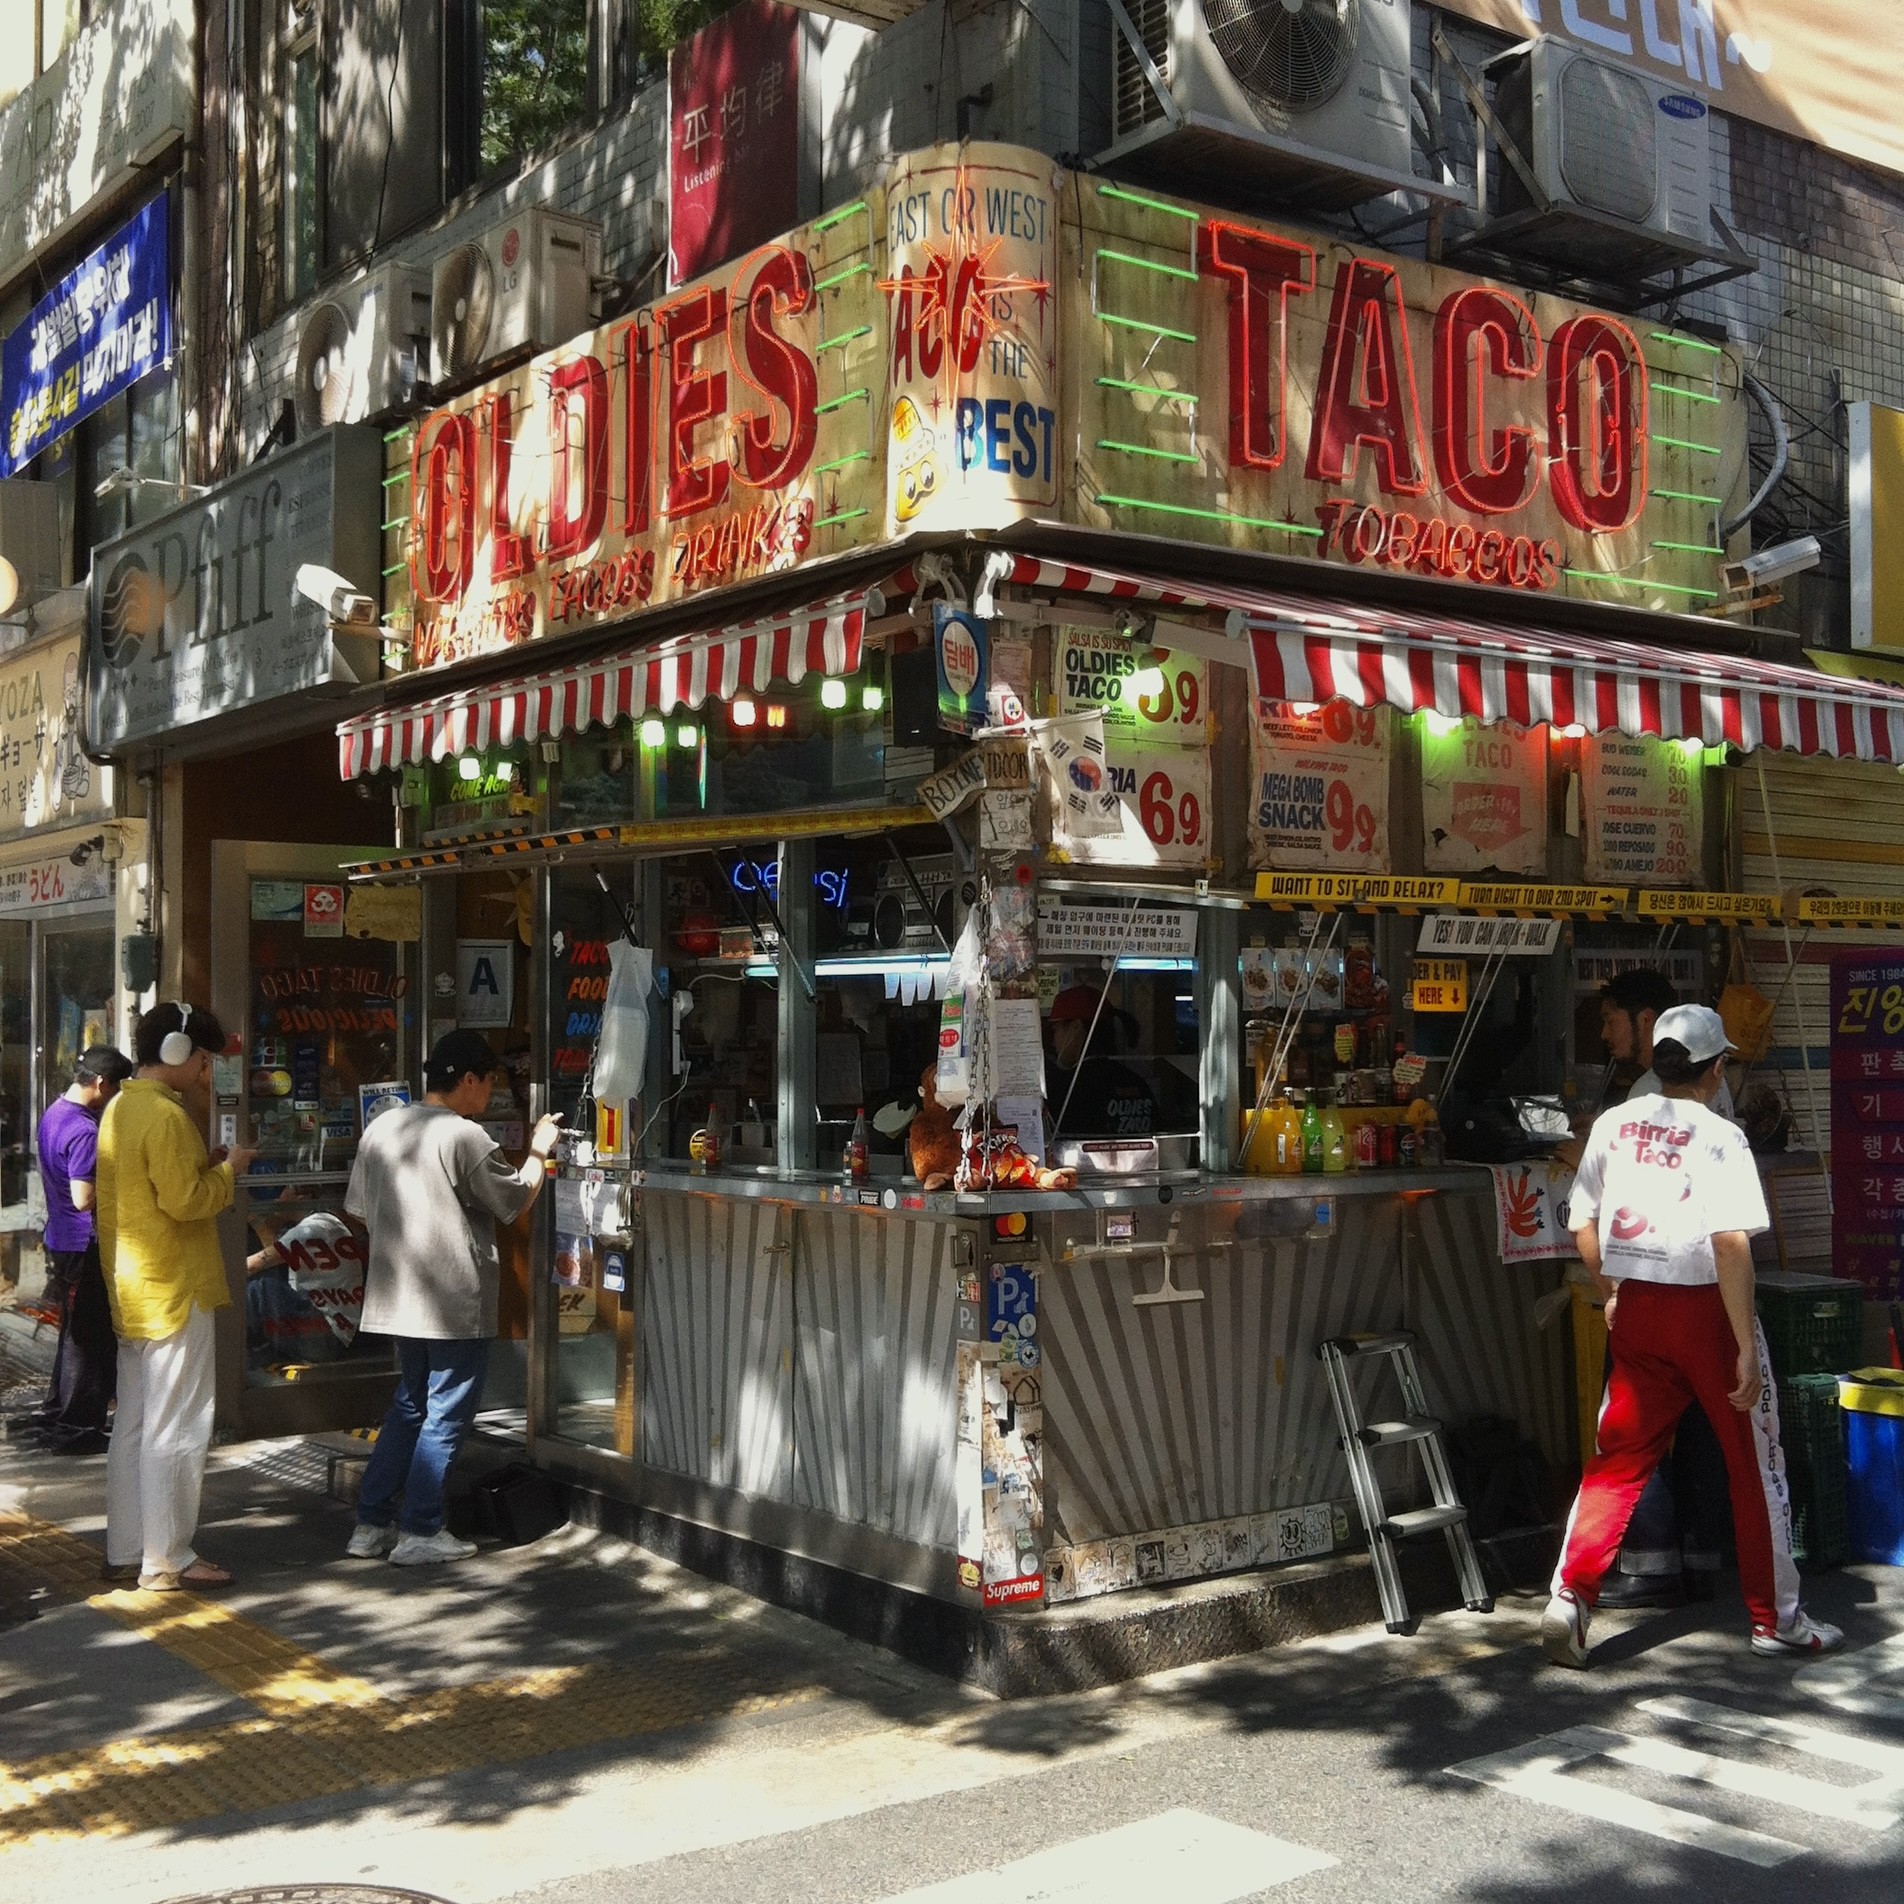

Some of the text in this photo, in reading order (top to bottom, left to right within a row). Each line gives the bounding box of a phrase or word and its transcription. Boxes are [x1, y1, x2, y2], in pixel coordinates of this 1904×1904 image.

[1662, 96, 1704, 118] SAMSUNG
[889, 187, 1047, 253] EAST OR WEST
[503, 274, 518, 294] LG
[888, 252, 985, 387] ACO
[988, 340, 1028, 380] THE
[1198, 218, 1649, 533] TACO
[412, 245, 817, 604] OLDIES
[955, 397, 1055, 483] BEST
[1315, 499, 1561, 590] TOBACCOS
[550, 545, 655, 622] TACOS
[1068, 631, 1091, 648] SALSA
[944, 639, 975, 677] 담배
[1066, 648, 1135, 677] OLDIES
[1065, 674, 1121, 702] TACO
[1463, 740, 1512, 769] TACO
[451, 778, 483, 800] COME
[1261, 773, 1324, 804] MEGA BOMB
[1607, 786, 1638, 797] WATER
[1140, 771, 1200, 846] 6.9
[1259, 802, 1326, 831] SNACK
[1326, 780, 1375, 854] 9.9
[1623, 822, 1656, 835] CUERVO
[29, 864, 64, 903] うどん
[1272, 876, 1445, 900] WANT TO SIT AND RELAX?
[1469, 887, 1493, 904] TURN
[1495, 888, 1521, 905] RIGHT
[1523, 889, 1536, 905] TO
[1537, 889, 1555, 906] OUR
[1576, 890, 1599, 908] SPOT
[1650, 894, 1675, 911] 당신은
[1706, 896, 1731, 912] 드시고
[1433, 920, 1454, 944] YES!
[1455, 920, 1475, 944] YOU
[1475, 921, 1495, 945] CAN
[1525, 922, 1551, 946] WALK
[469, 957, 499, 996] A
[1443, 964, 1461, 980] PAY
[1849, 969, 1877, 983] SINCE
[1418, 987, 1443, 1005] HERE
[1107, 1099, 1151, 1117] OLDIES
[325, 1126, 352, 1139] VISA
[1619, 1120, 1692, 1147] Birria
[1634, 1140, 1681, 1170] Taco
[998, 1277, 1019, 1315] P
[986, 1578, 1041, 1602] Supreme
